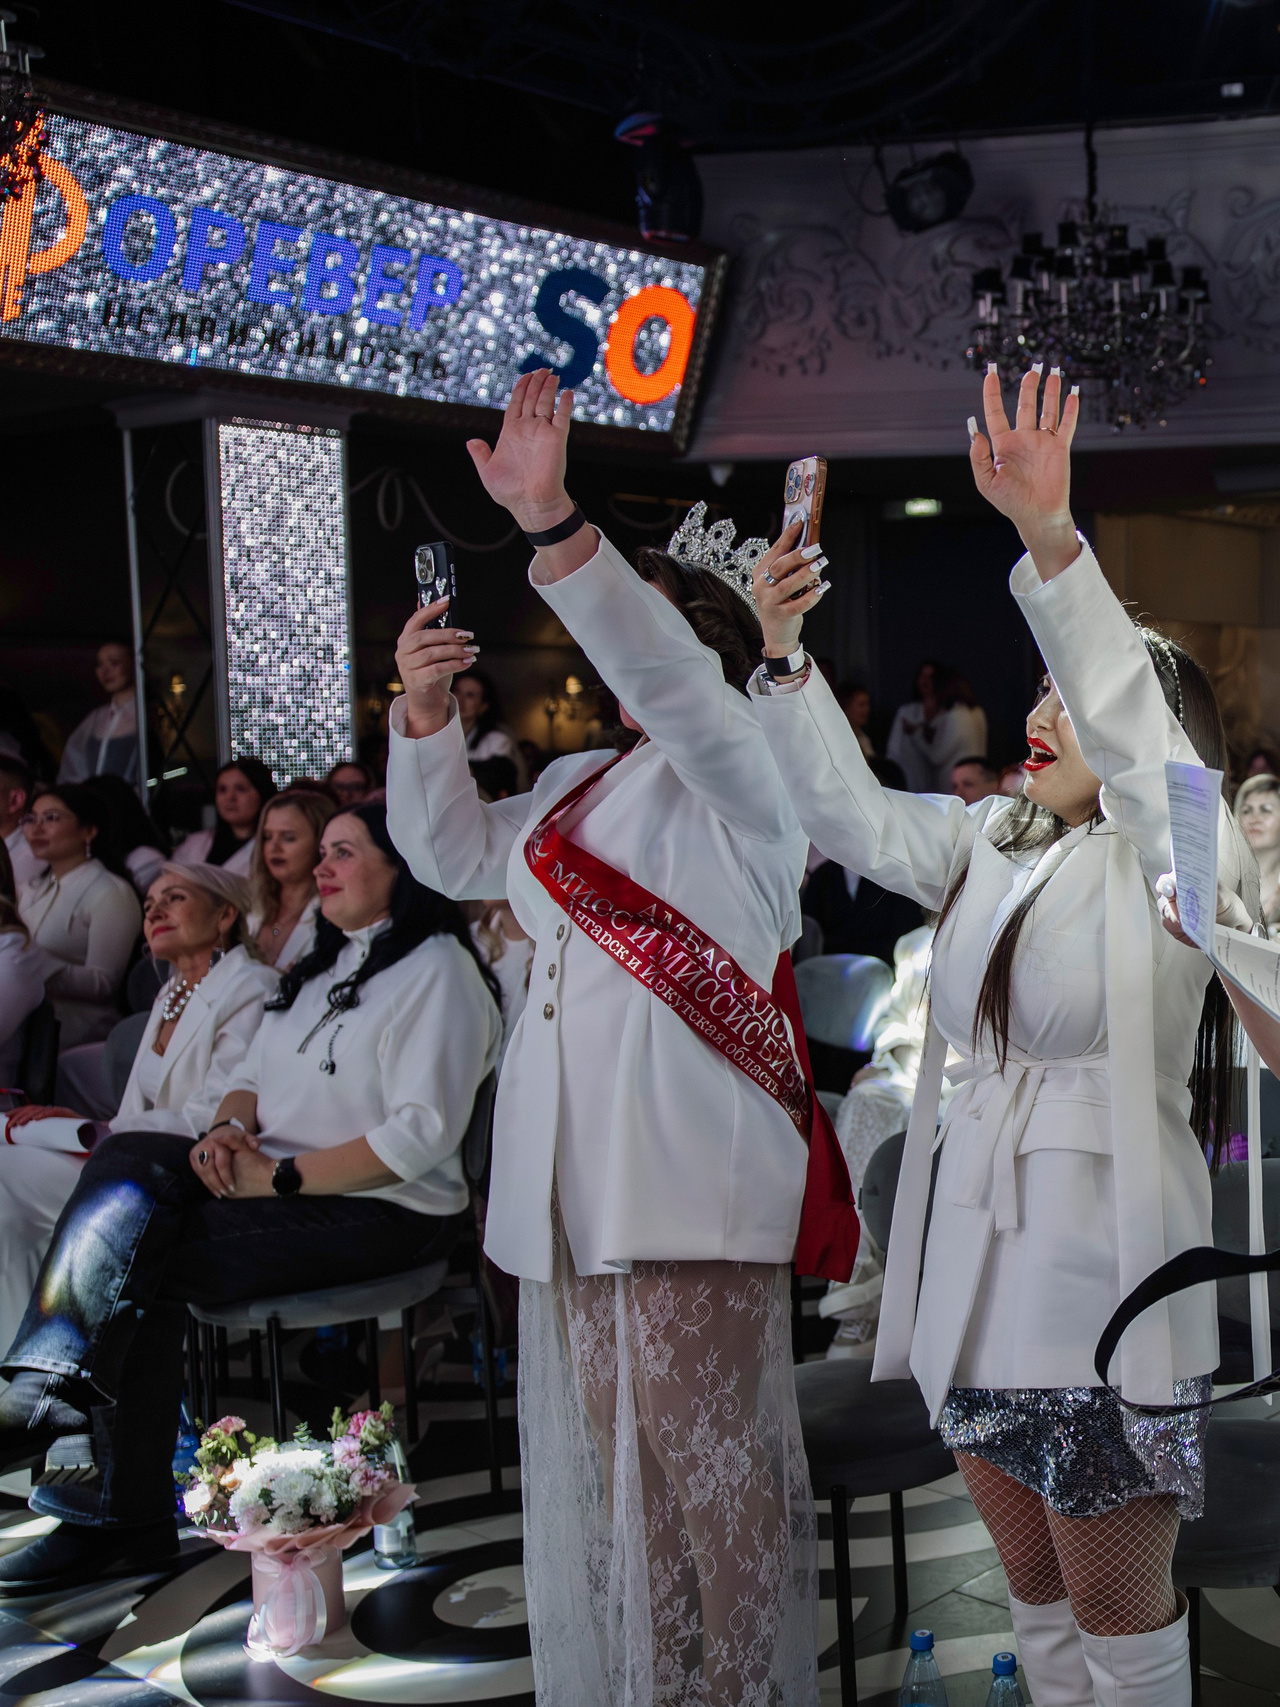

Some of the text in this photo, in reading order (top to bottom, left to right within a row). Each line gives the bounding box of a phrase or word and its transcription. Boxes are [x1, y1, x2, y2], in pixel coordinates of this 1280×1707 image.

[549, 860, 633, 930] МИСС
[627, 921, 662, 952] И
[649, 938, 764, 1045] МИССИС
[562, 901, 630, 960] Ангарск
[625, 954, 643, 972] и
[639, 963, 728, 1046] Иркутская
[725, 1043, 779, 1096] область
[637, 903, 791, 1049] АМБАССАДО
